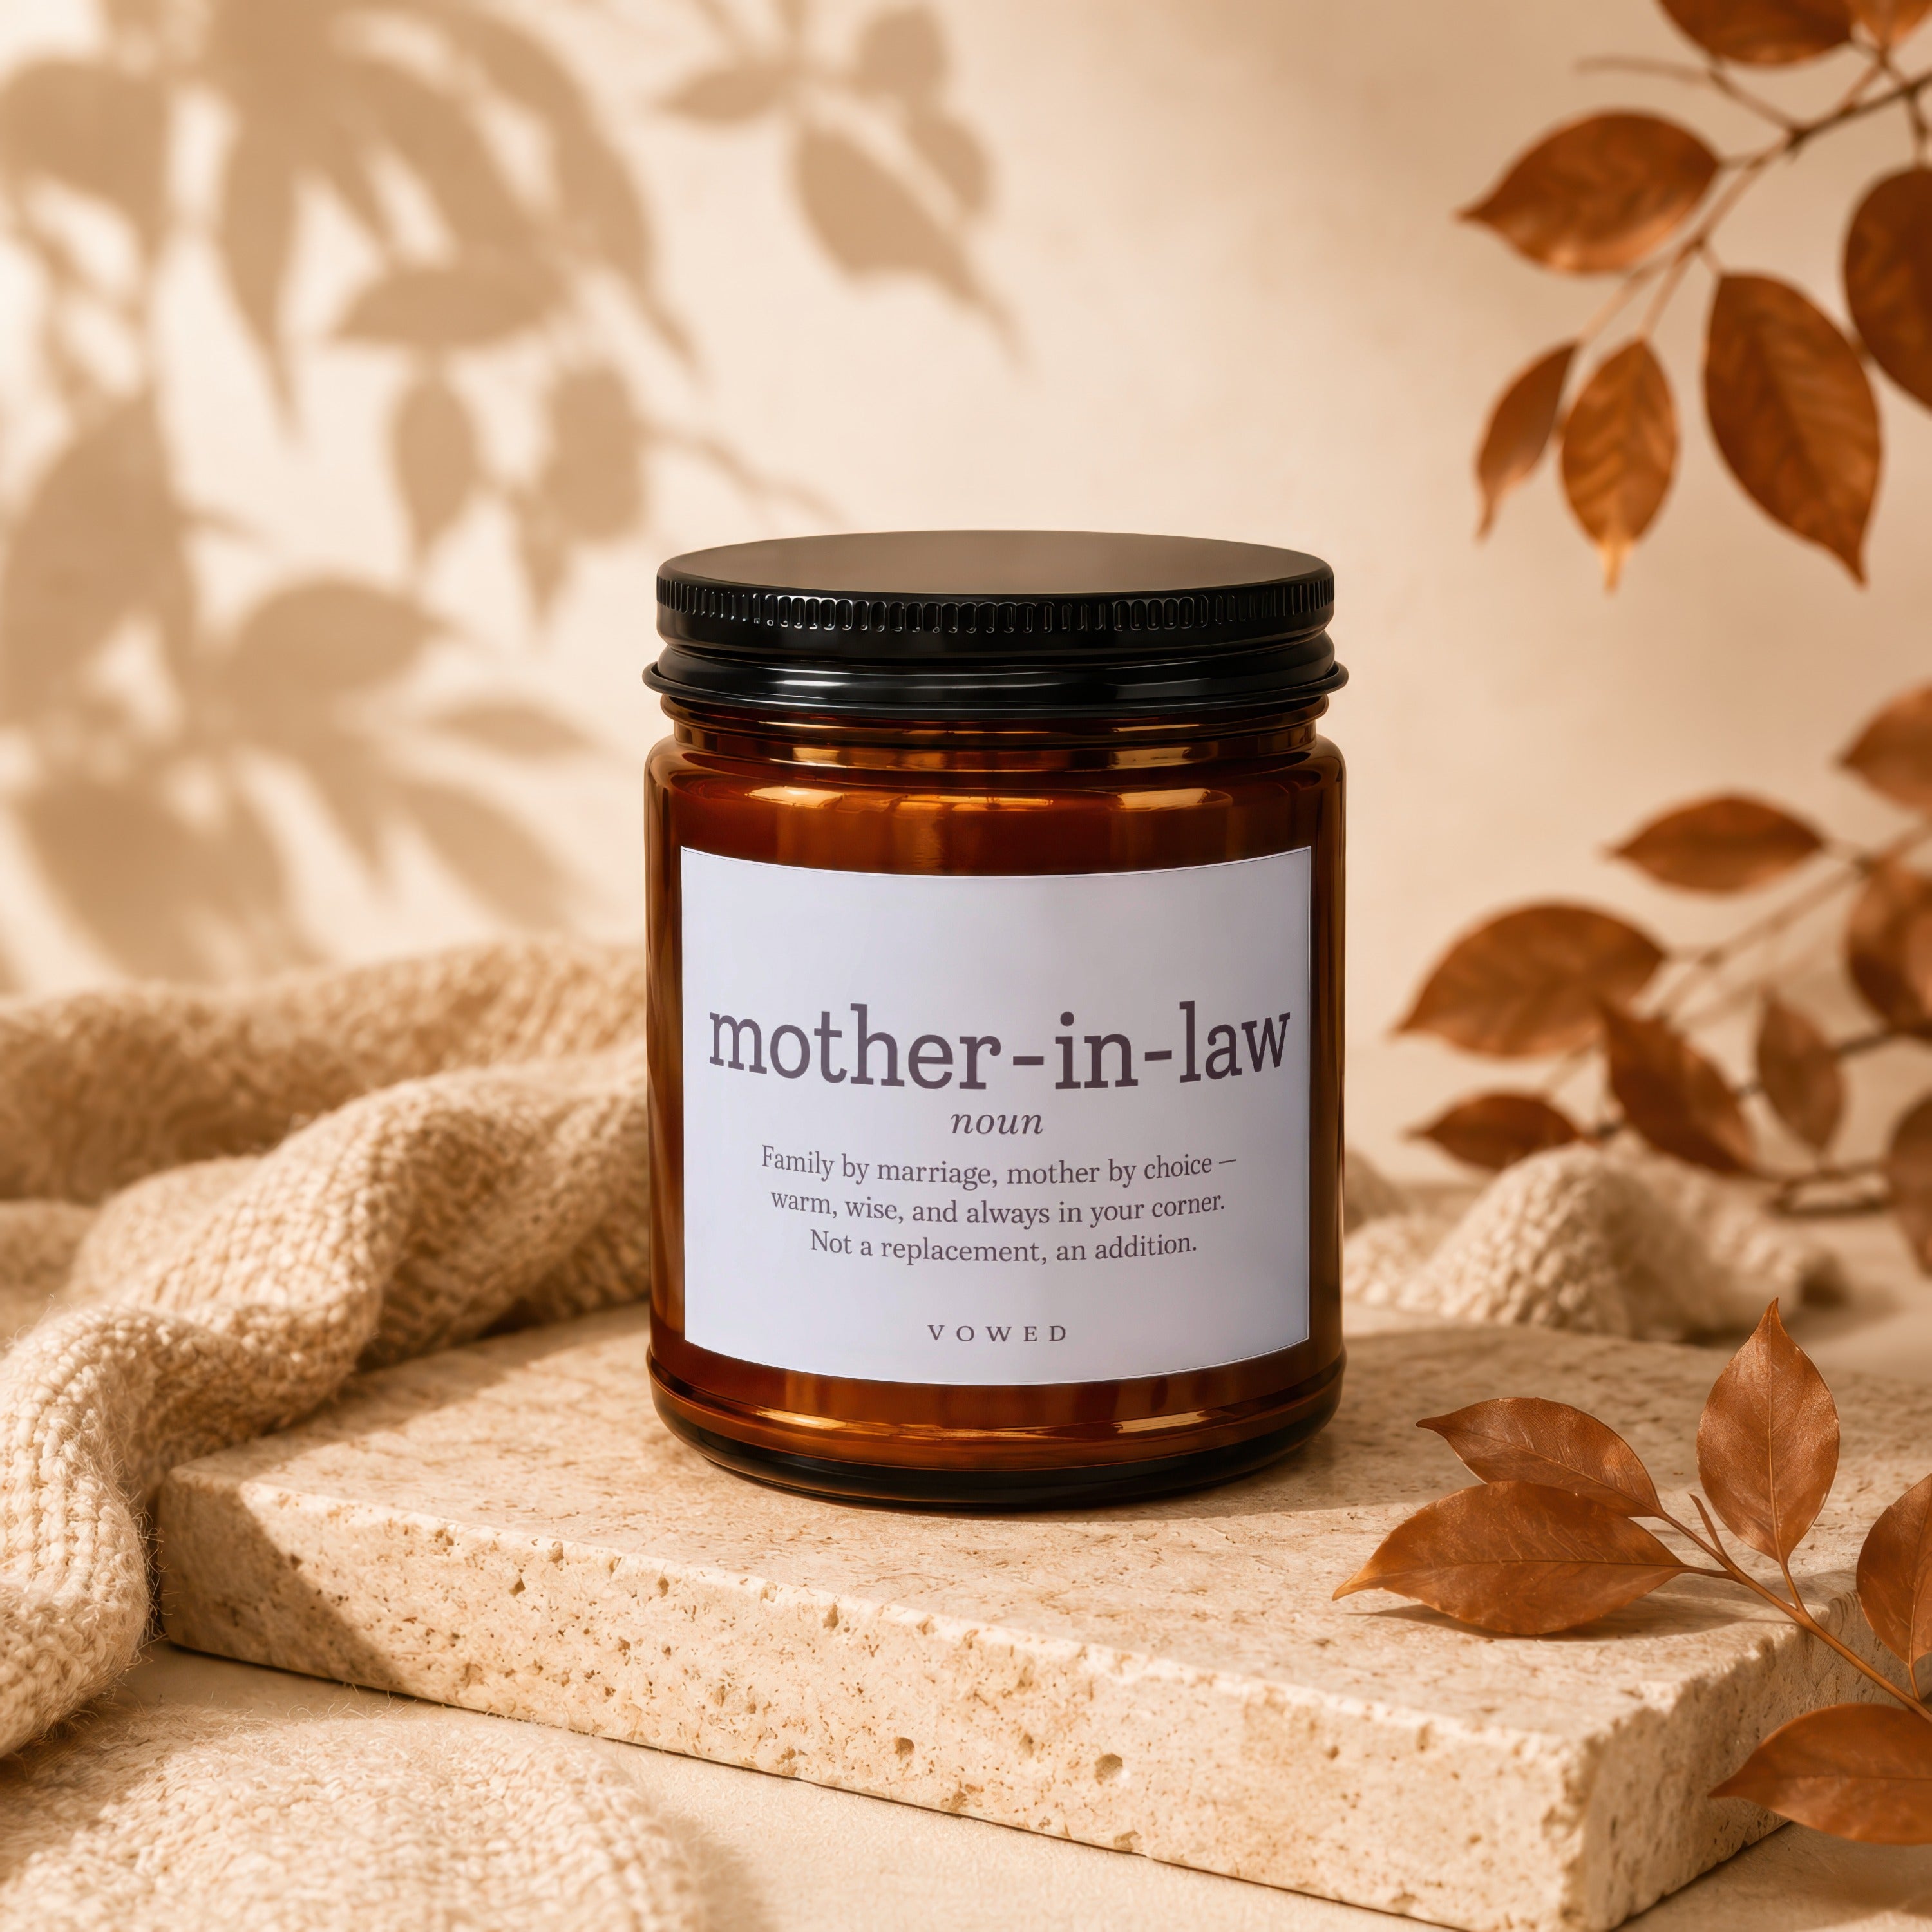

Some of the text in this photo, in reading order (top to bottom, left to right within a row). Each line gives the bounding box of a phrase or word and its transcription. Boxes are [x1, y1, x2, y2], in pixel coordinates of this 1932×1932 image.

[709, 1000, 1291, 1090] mother-in-law
[951, 1113, 1043, 1135] noun
[761, 1144, 835, 1182] Family
[841, 1153, 870, 1186] by
[876, 1160, 998, 1191] marriage,
[1007, 1158, 1101, 1184] mother
[1107, 1158, 1137, 1189] by
[1144, 1153, 1212, 1180] choice
[770, 1191, 1226, 1231] warm, wise, and always in your corner.
[810, 1229, 1197, 1266] Not a replacement, an addition.
[927, 1324, 1067, 1342] VOWED
